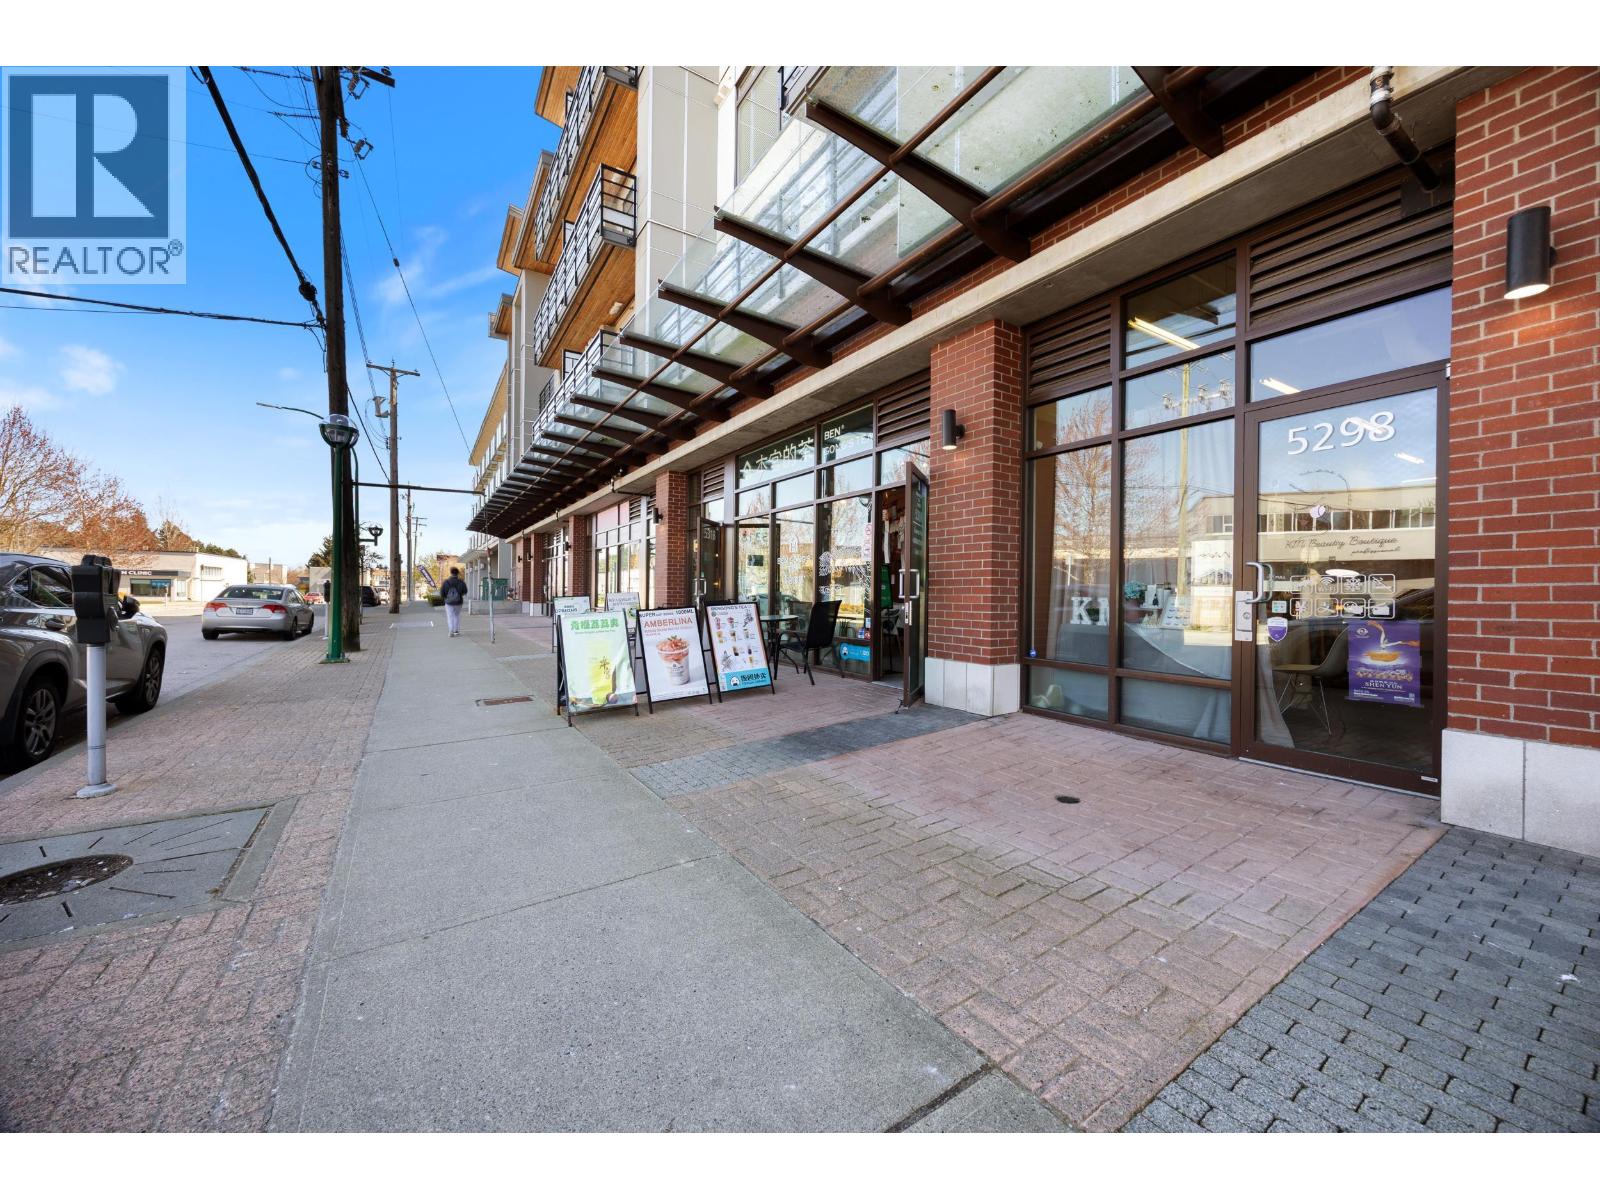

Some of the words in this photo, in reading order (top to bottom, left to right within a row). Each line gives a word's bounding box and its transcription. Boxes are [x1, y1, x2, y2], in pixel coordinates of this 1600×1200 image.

[1287, 411, 1396, 455] 5298
[1349, 535, 1398, 547] Boutique
[644, 616, 693, 629] AMBERLINA
